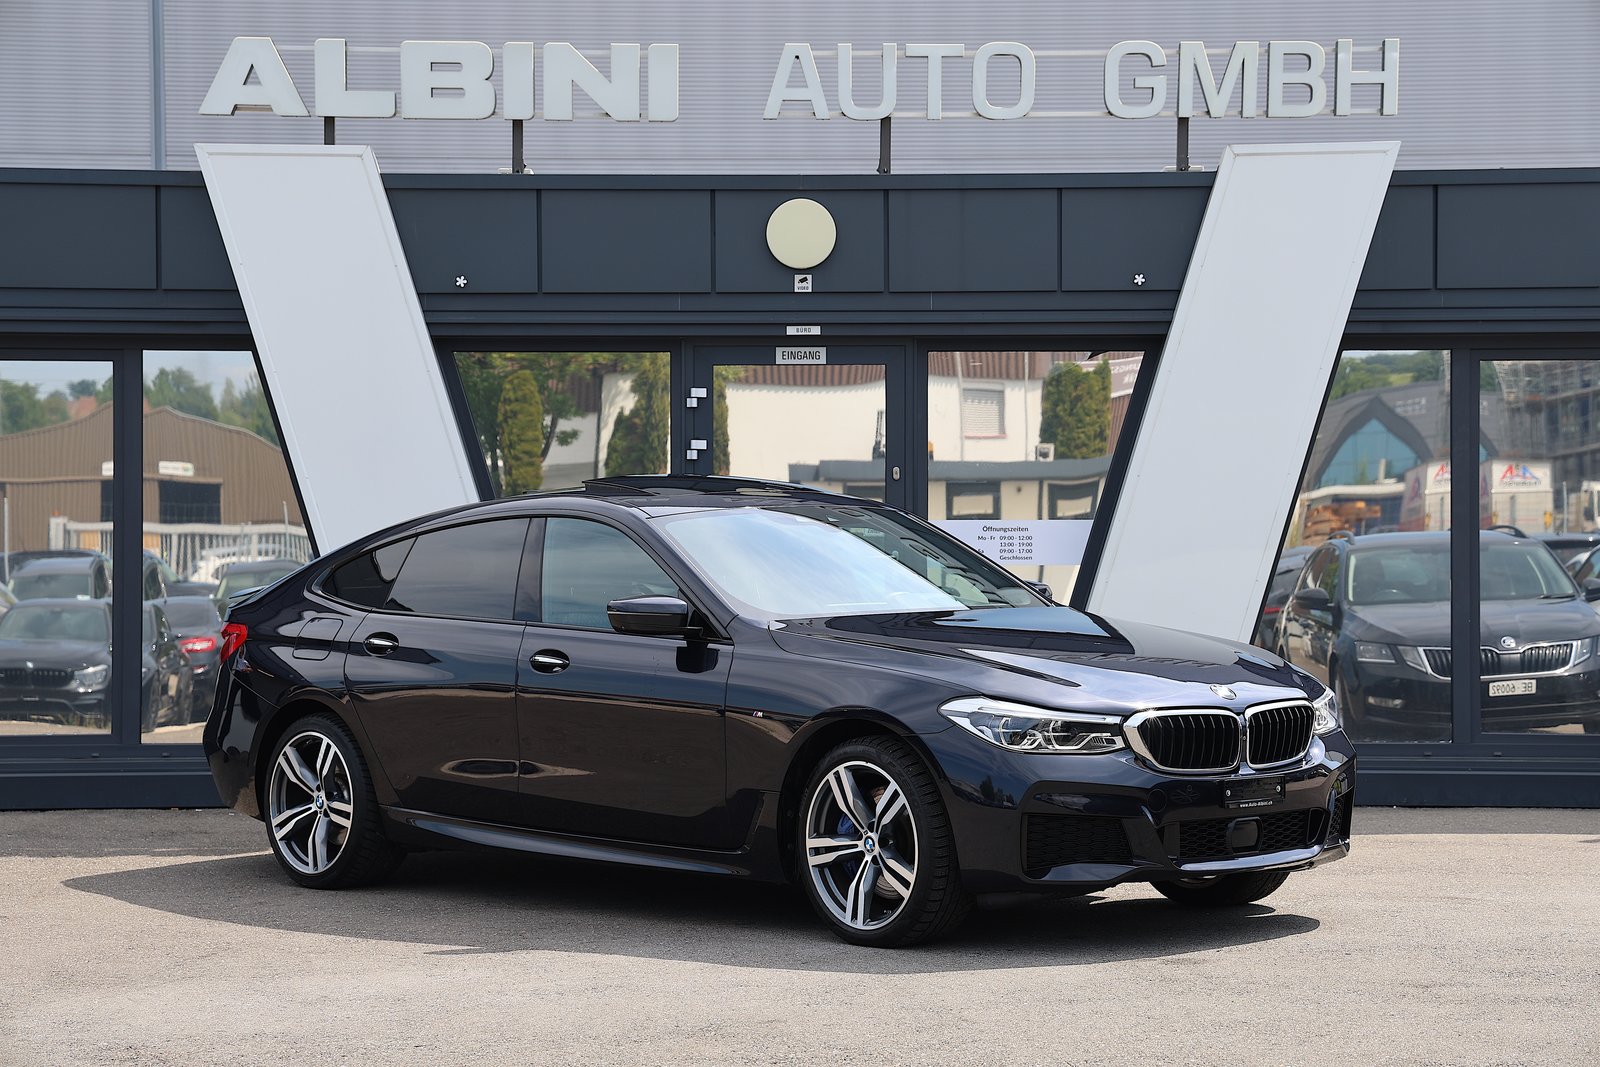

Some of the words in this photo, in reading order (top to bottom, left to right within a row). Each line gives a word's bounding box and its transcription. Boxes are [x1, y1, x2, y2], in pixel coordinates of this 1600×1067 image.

[198, 36, 680, 122] ALBINI
[763, 41, 1036, 120] AUTO
[1104, 38, 1400, 119] GMBH
[782, 350, 820, 360] EINGANG
